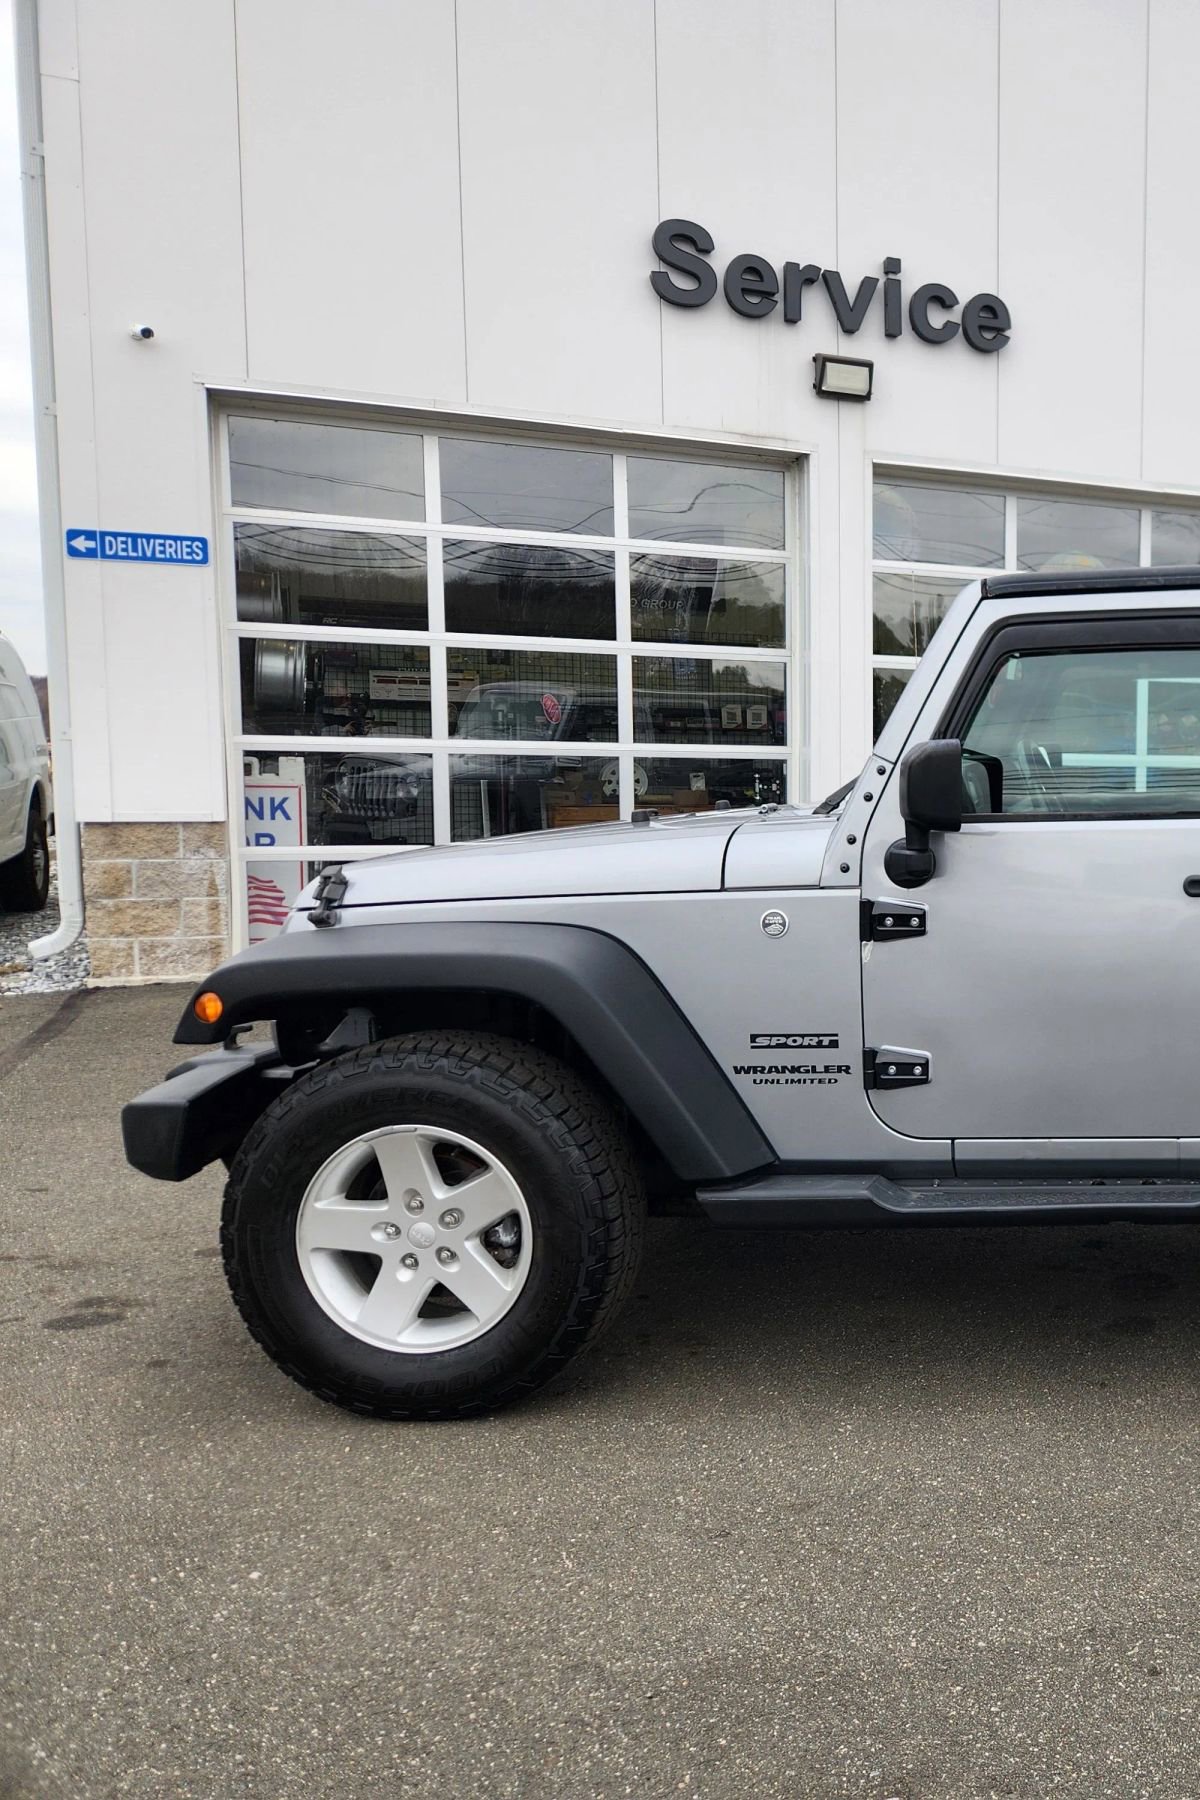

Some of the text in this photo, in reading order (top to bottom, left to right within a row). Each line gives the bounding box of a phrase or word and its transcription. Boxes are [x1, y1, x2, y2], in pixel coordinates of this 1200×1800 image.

[650, 218, 1012, 354] Service
[104, 535, 204, 561] DELIVERIES
[641, 598, 684, 610] GROUP
[750, 1035, 839, 1048] SPORT
[732, 1064, 853, 1076] WRANGLER
[752, 1077, 839, 1086] UNLIMITED
